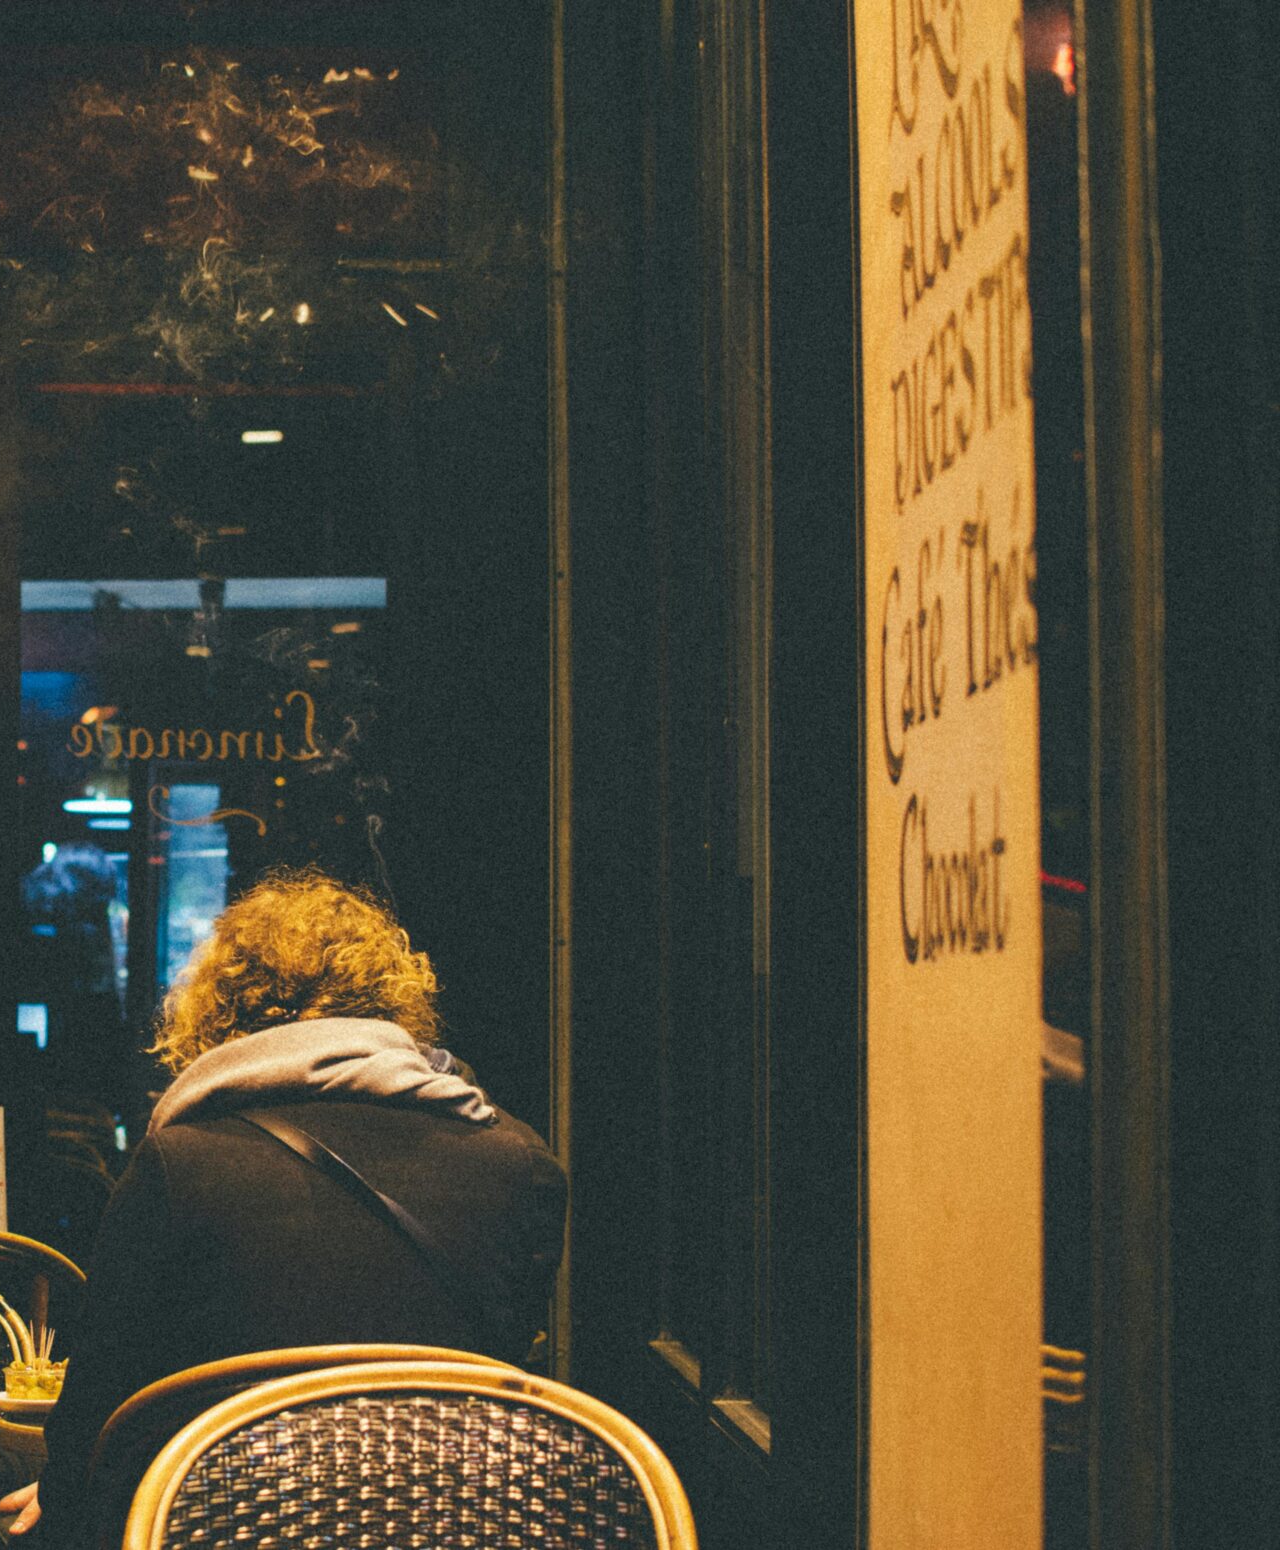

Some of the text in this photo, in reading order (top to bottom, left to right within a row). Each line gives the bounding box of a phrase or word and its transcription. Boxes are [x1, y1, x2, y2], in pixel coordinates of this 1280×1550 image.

[891, 233, 1032, 516] DIGESTIF
[880, 525, 946, 785] Café
[900, 784, 1009, 965] Chocolat
